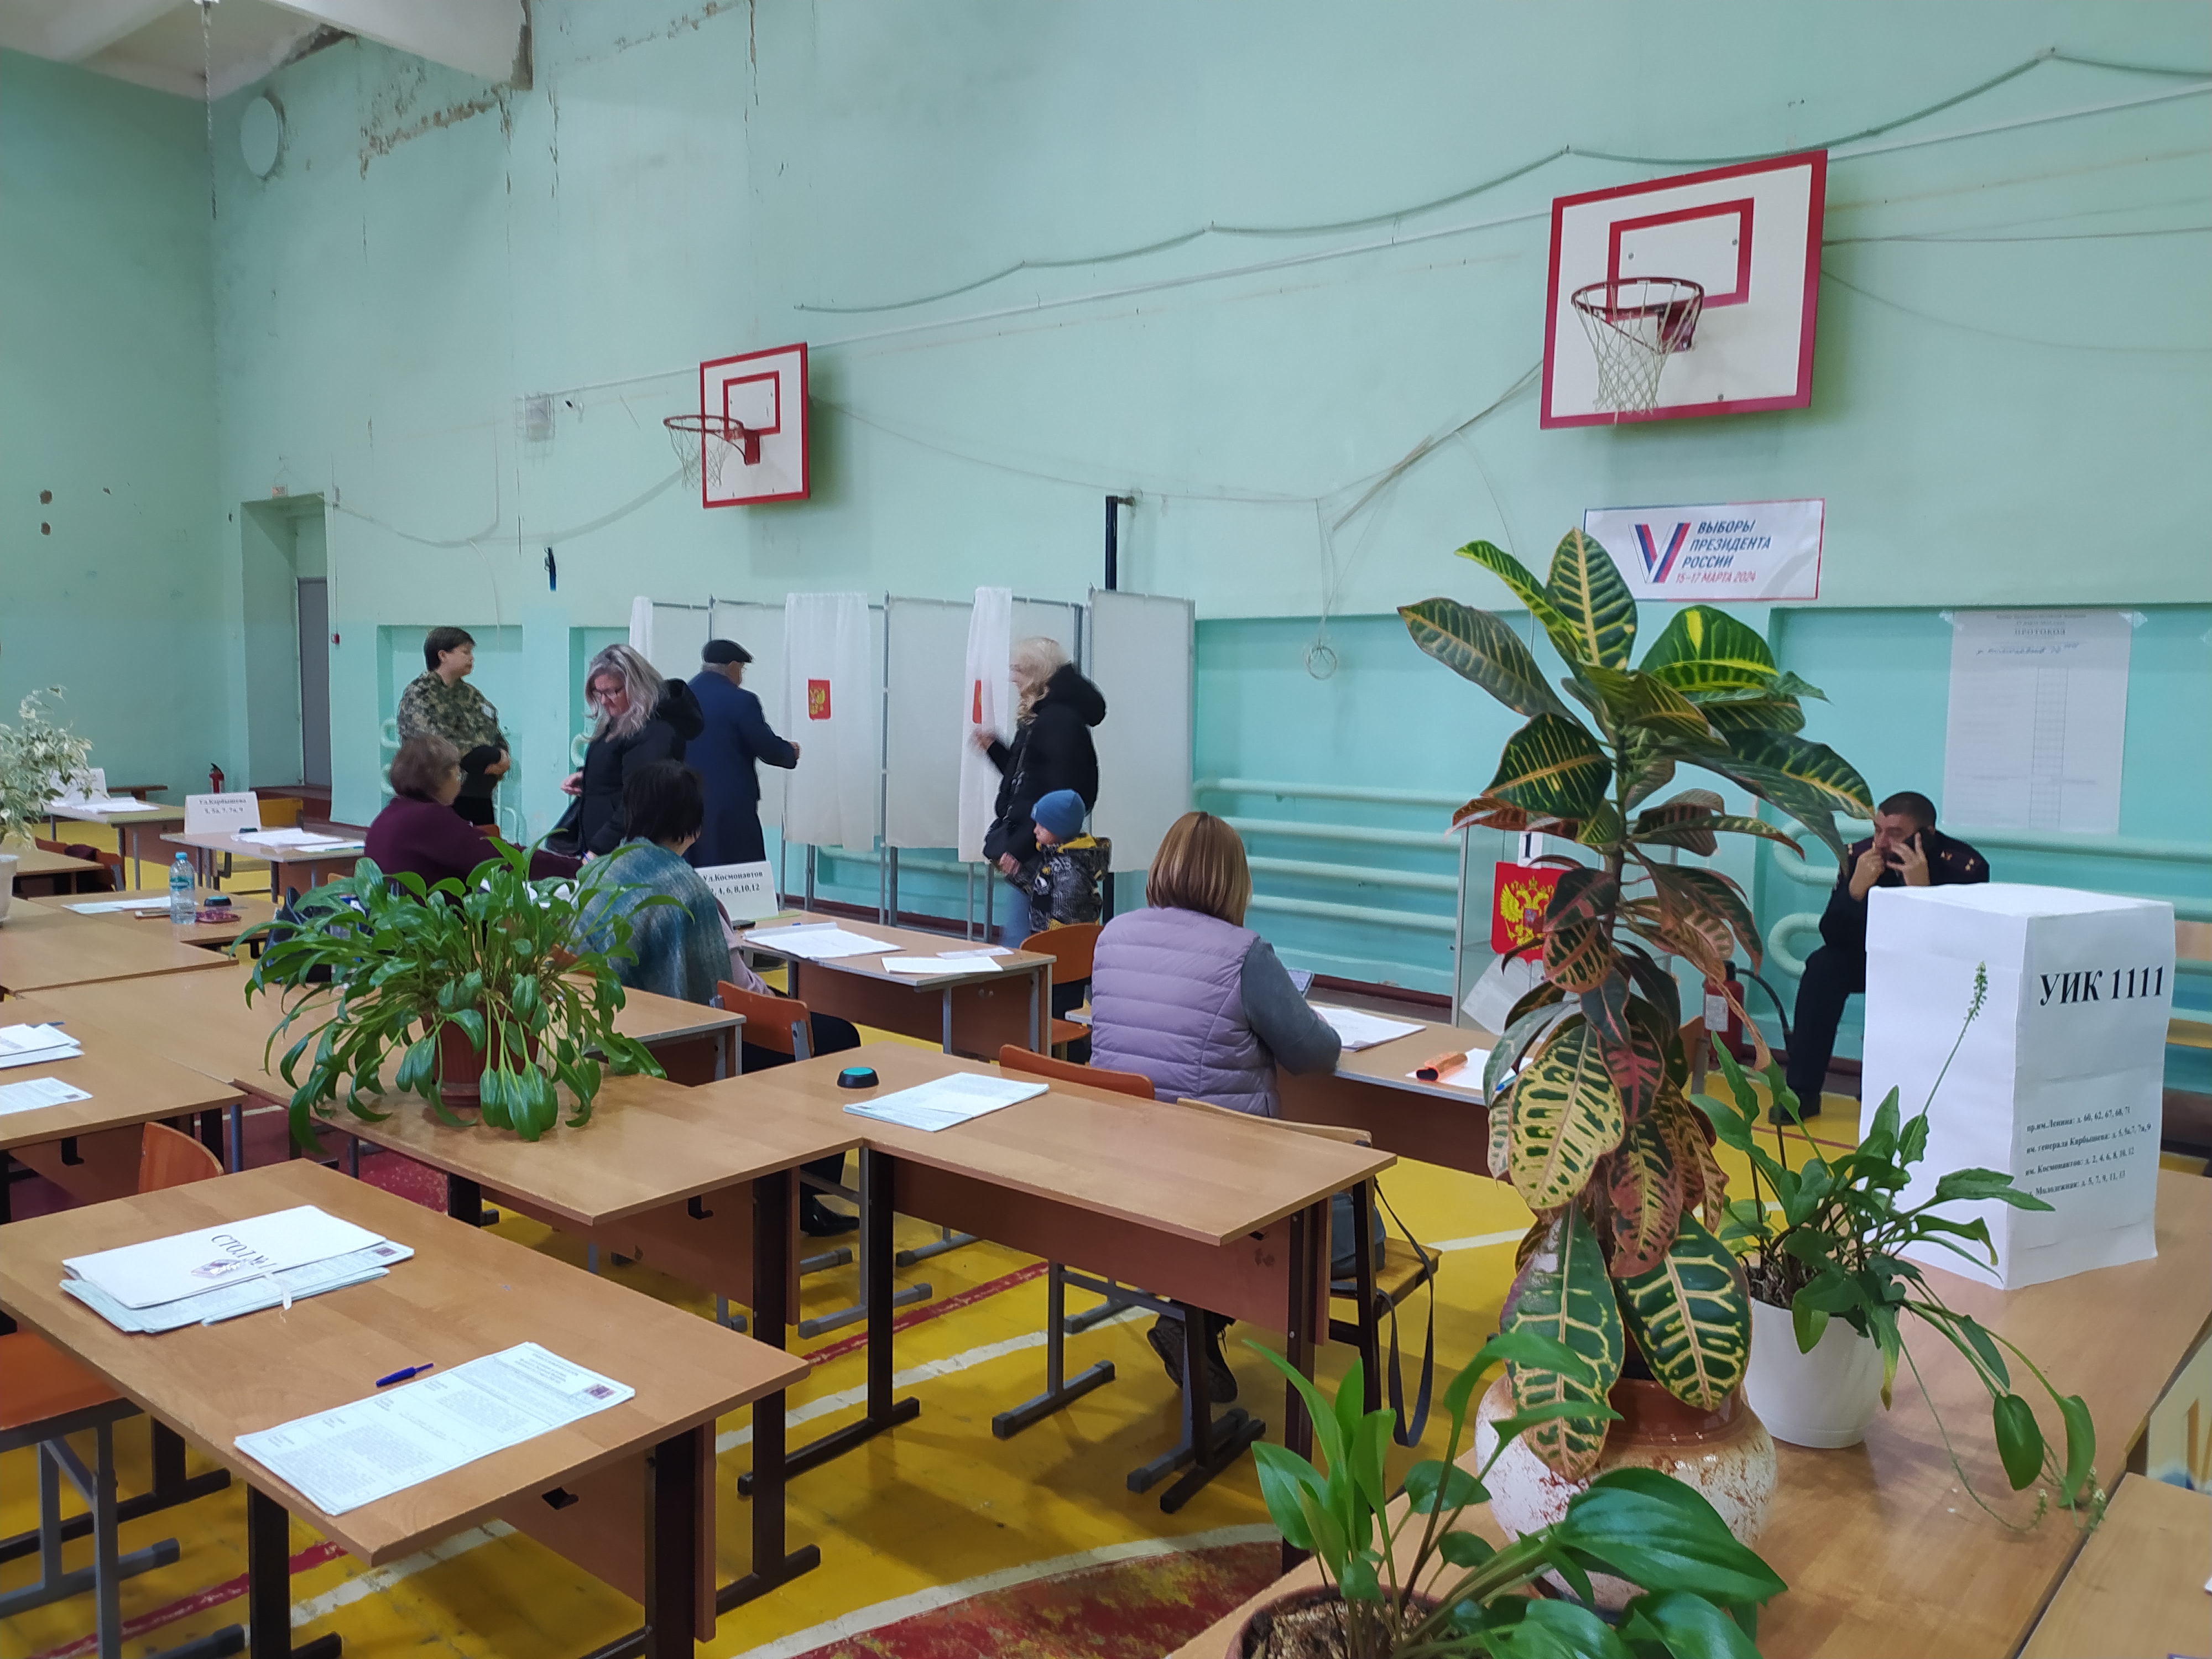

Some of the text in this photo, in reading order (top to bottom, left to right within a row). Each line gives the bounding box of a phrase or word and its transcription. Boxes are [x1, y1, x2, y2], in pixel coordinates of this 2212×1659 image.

[1697, 519, 1755, 534] ВЫБОРЫ
[1689, 536, 1771, 552] ПРЕЗИДЕНТА
[1682, 555, 1733, 568] РОССИИ
[1703, 572, 1732, 582] МАРТА
[1734, 570, 1756, 582] 2024
[2040, 966, 2163, 1006] УИК 1111
